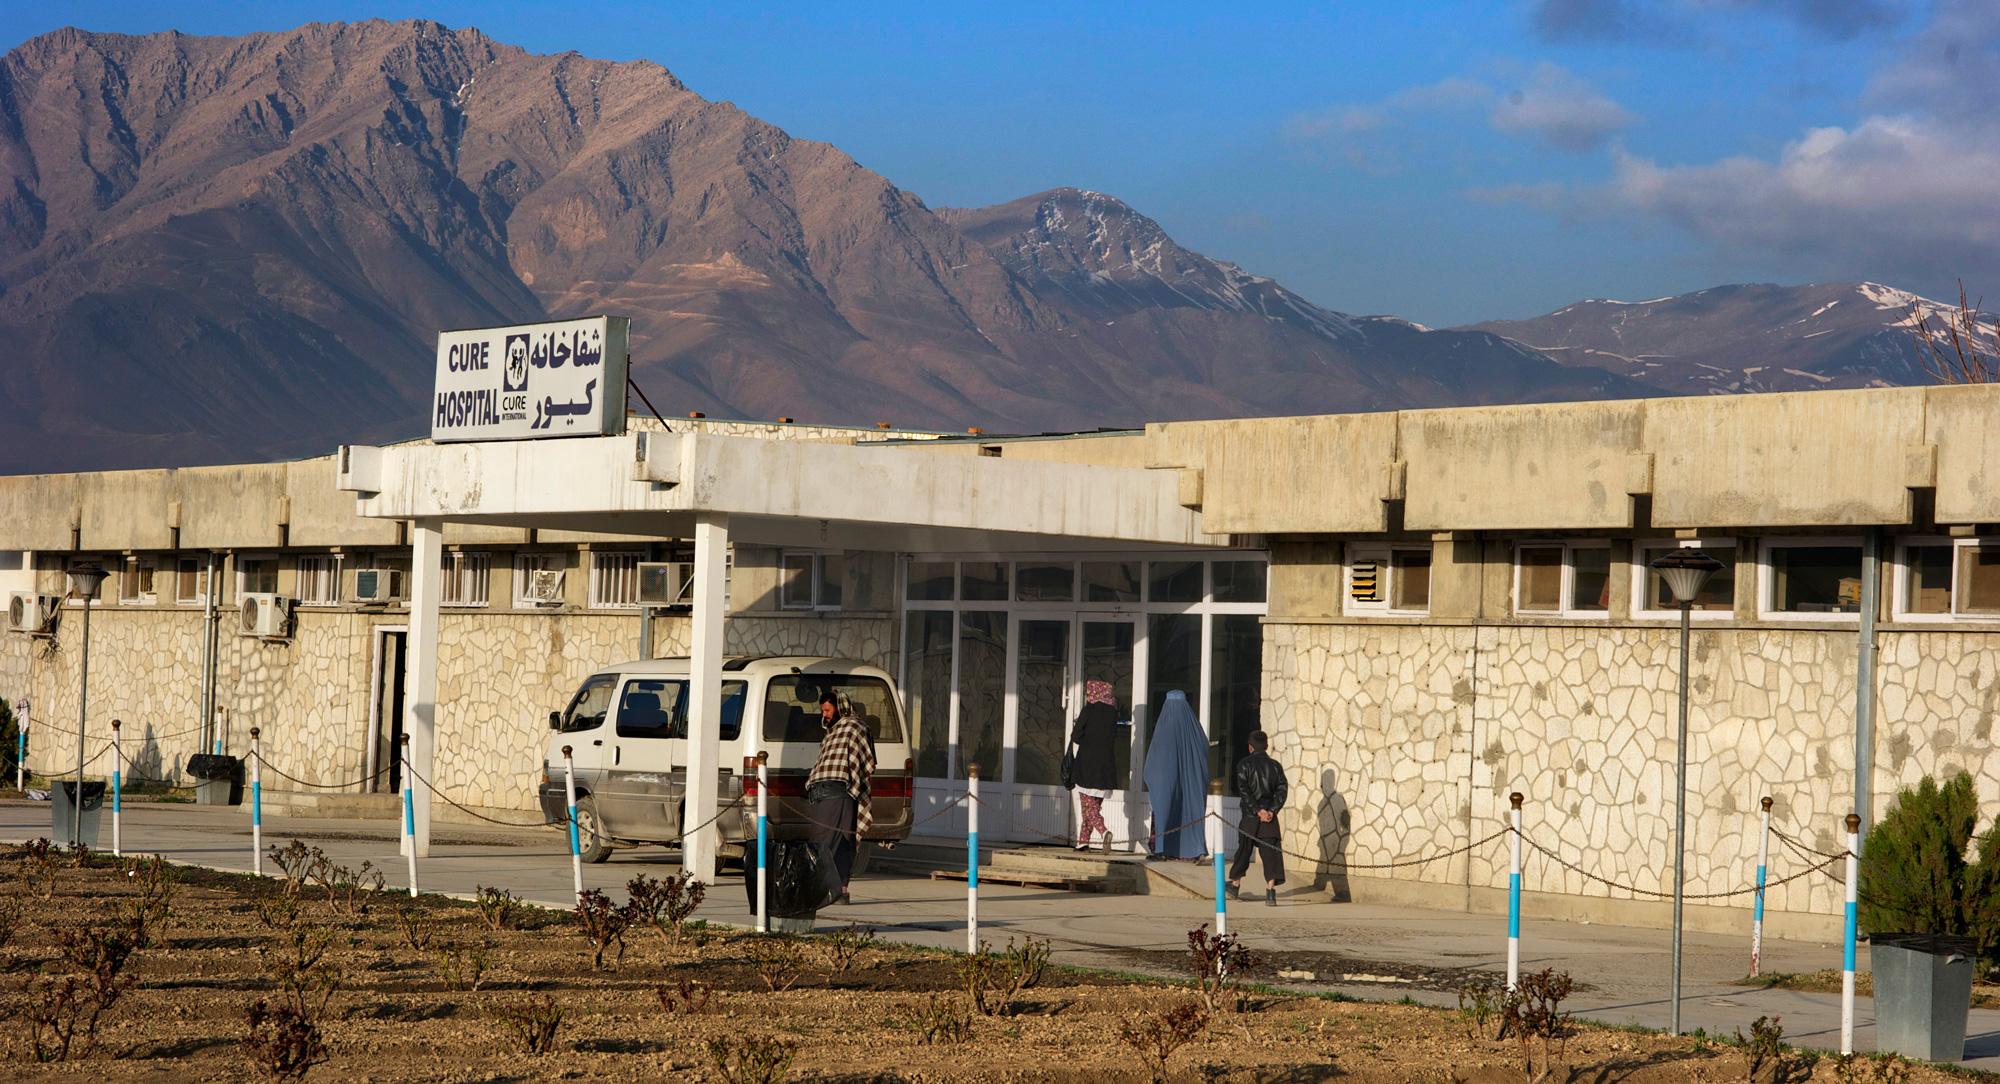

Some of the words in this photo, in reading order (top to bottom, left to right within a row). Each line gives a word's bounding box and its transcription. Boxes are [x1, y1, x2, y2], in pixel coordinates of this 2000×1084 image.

[449, 341, 490, 373] CURE
[530, 328, 602, 369] شفاخانه
[436, 388, 500, 428] HOSPITAL
[502, 395, 527, 411] CURE
[502, 412, 527, 421] INTERNATIONAL
